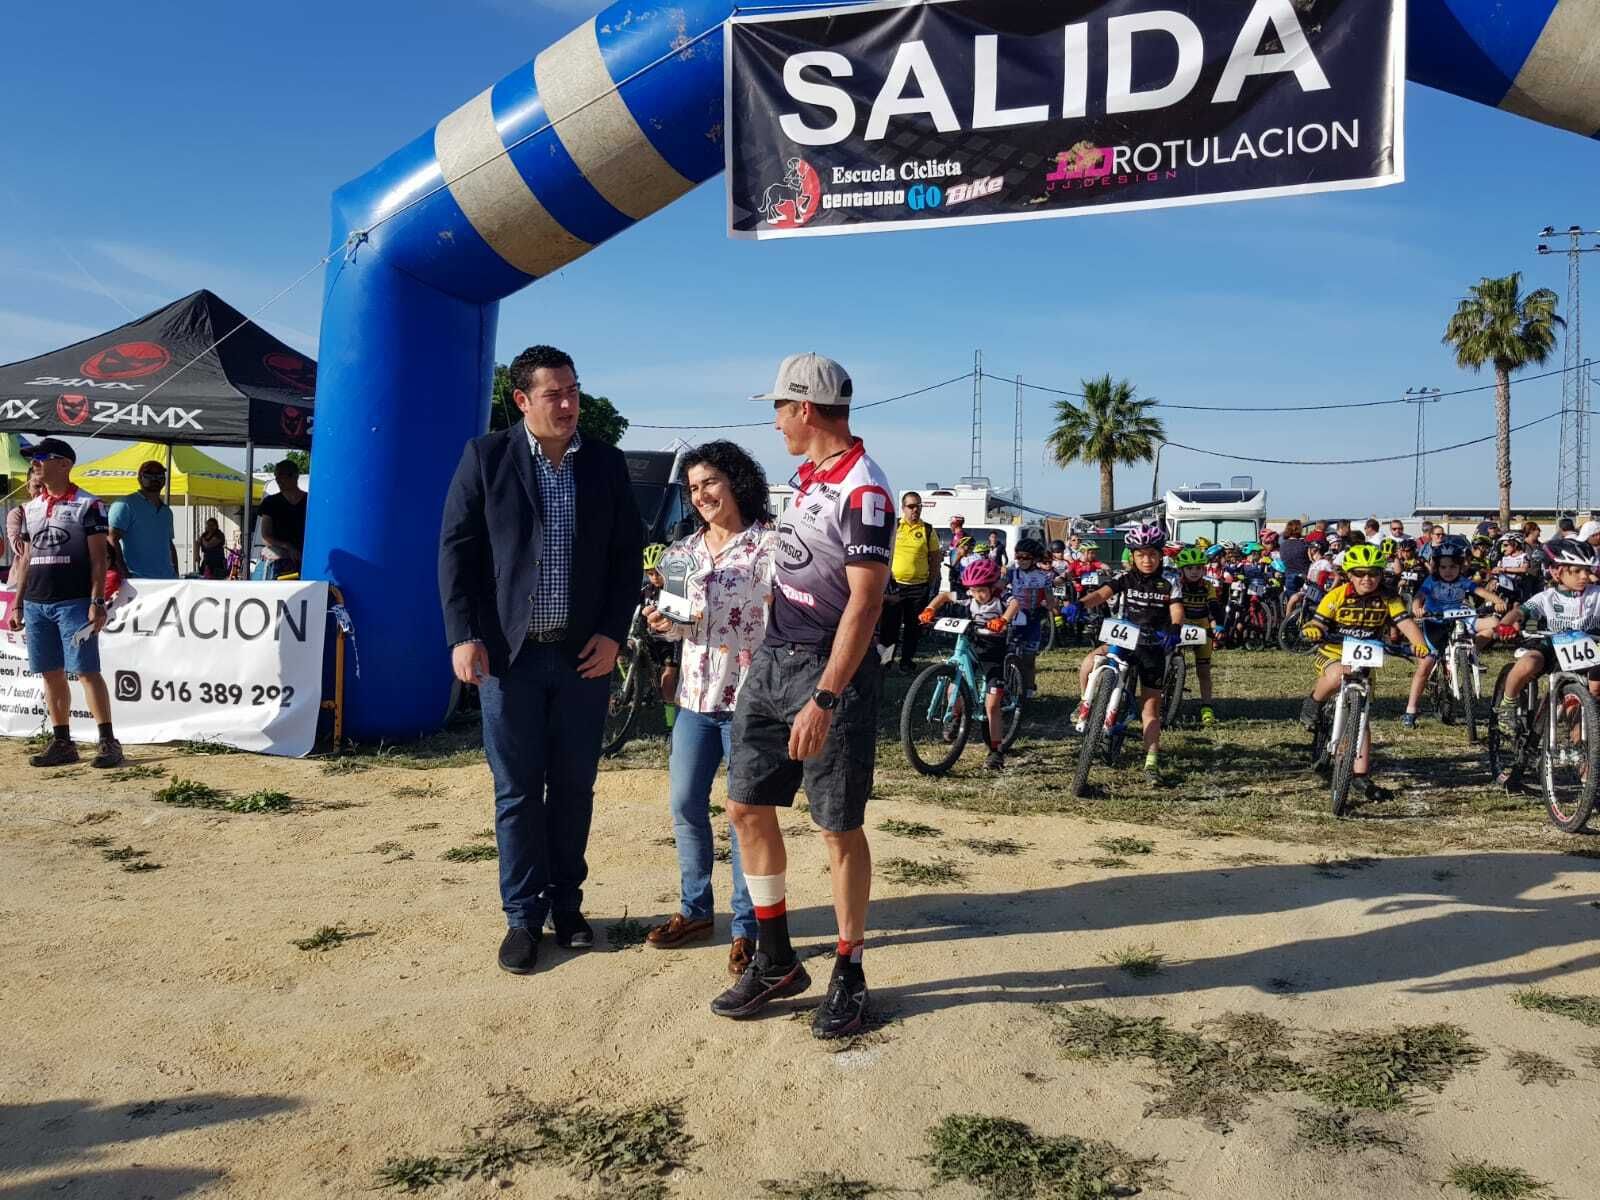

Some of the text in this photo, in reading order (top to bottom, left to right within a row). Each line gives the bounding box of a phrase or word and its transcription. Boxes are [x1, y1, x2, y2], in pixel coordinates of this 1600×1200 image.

[780, 0, 1331, 146] SALIDA
[1112, 119, 1359, 175] ROTULACION
[832, 159, 962, 184] Escuela Ciclista
[907, 184, 942, 211] GO
[92, 401, 204, 430] 24MX
[1111, 624, 1129, 641] 64
[1184, 629, 1199, 641] 62
[1353, 645, 1373, 661] 63
[1561, 641, 1595, 664] 146
[151, 680, 192, 703] 616
[199, 682, 242, 705] 389
